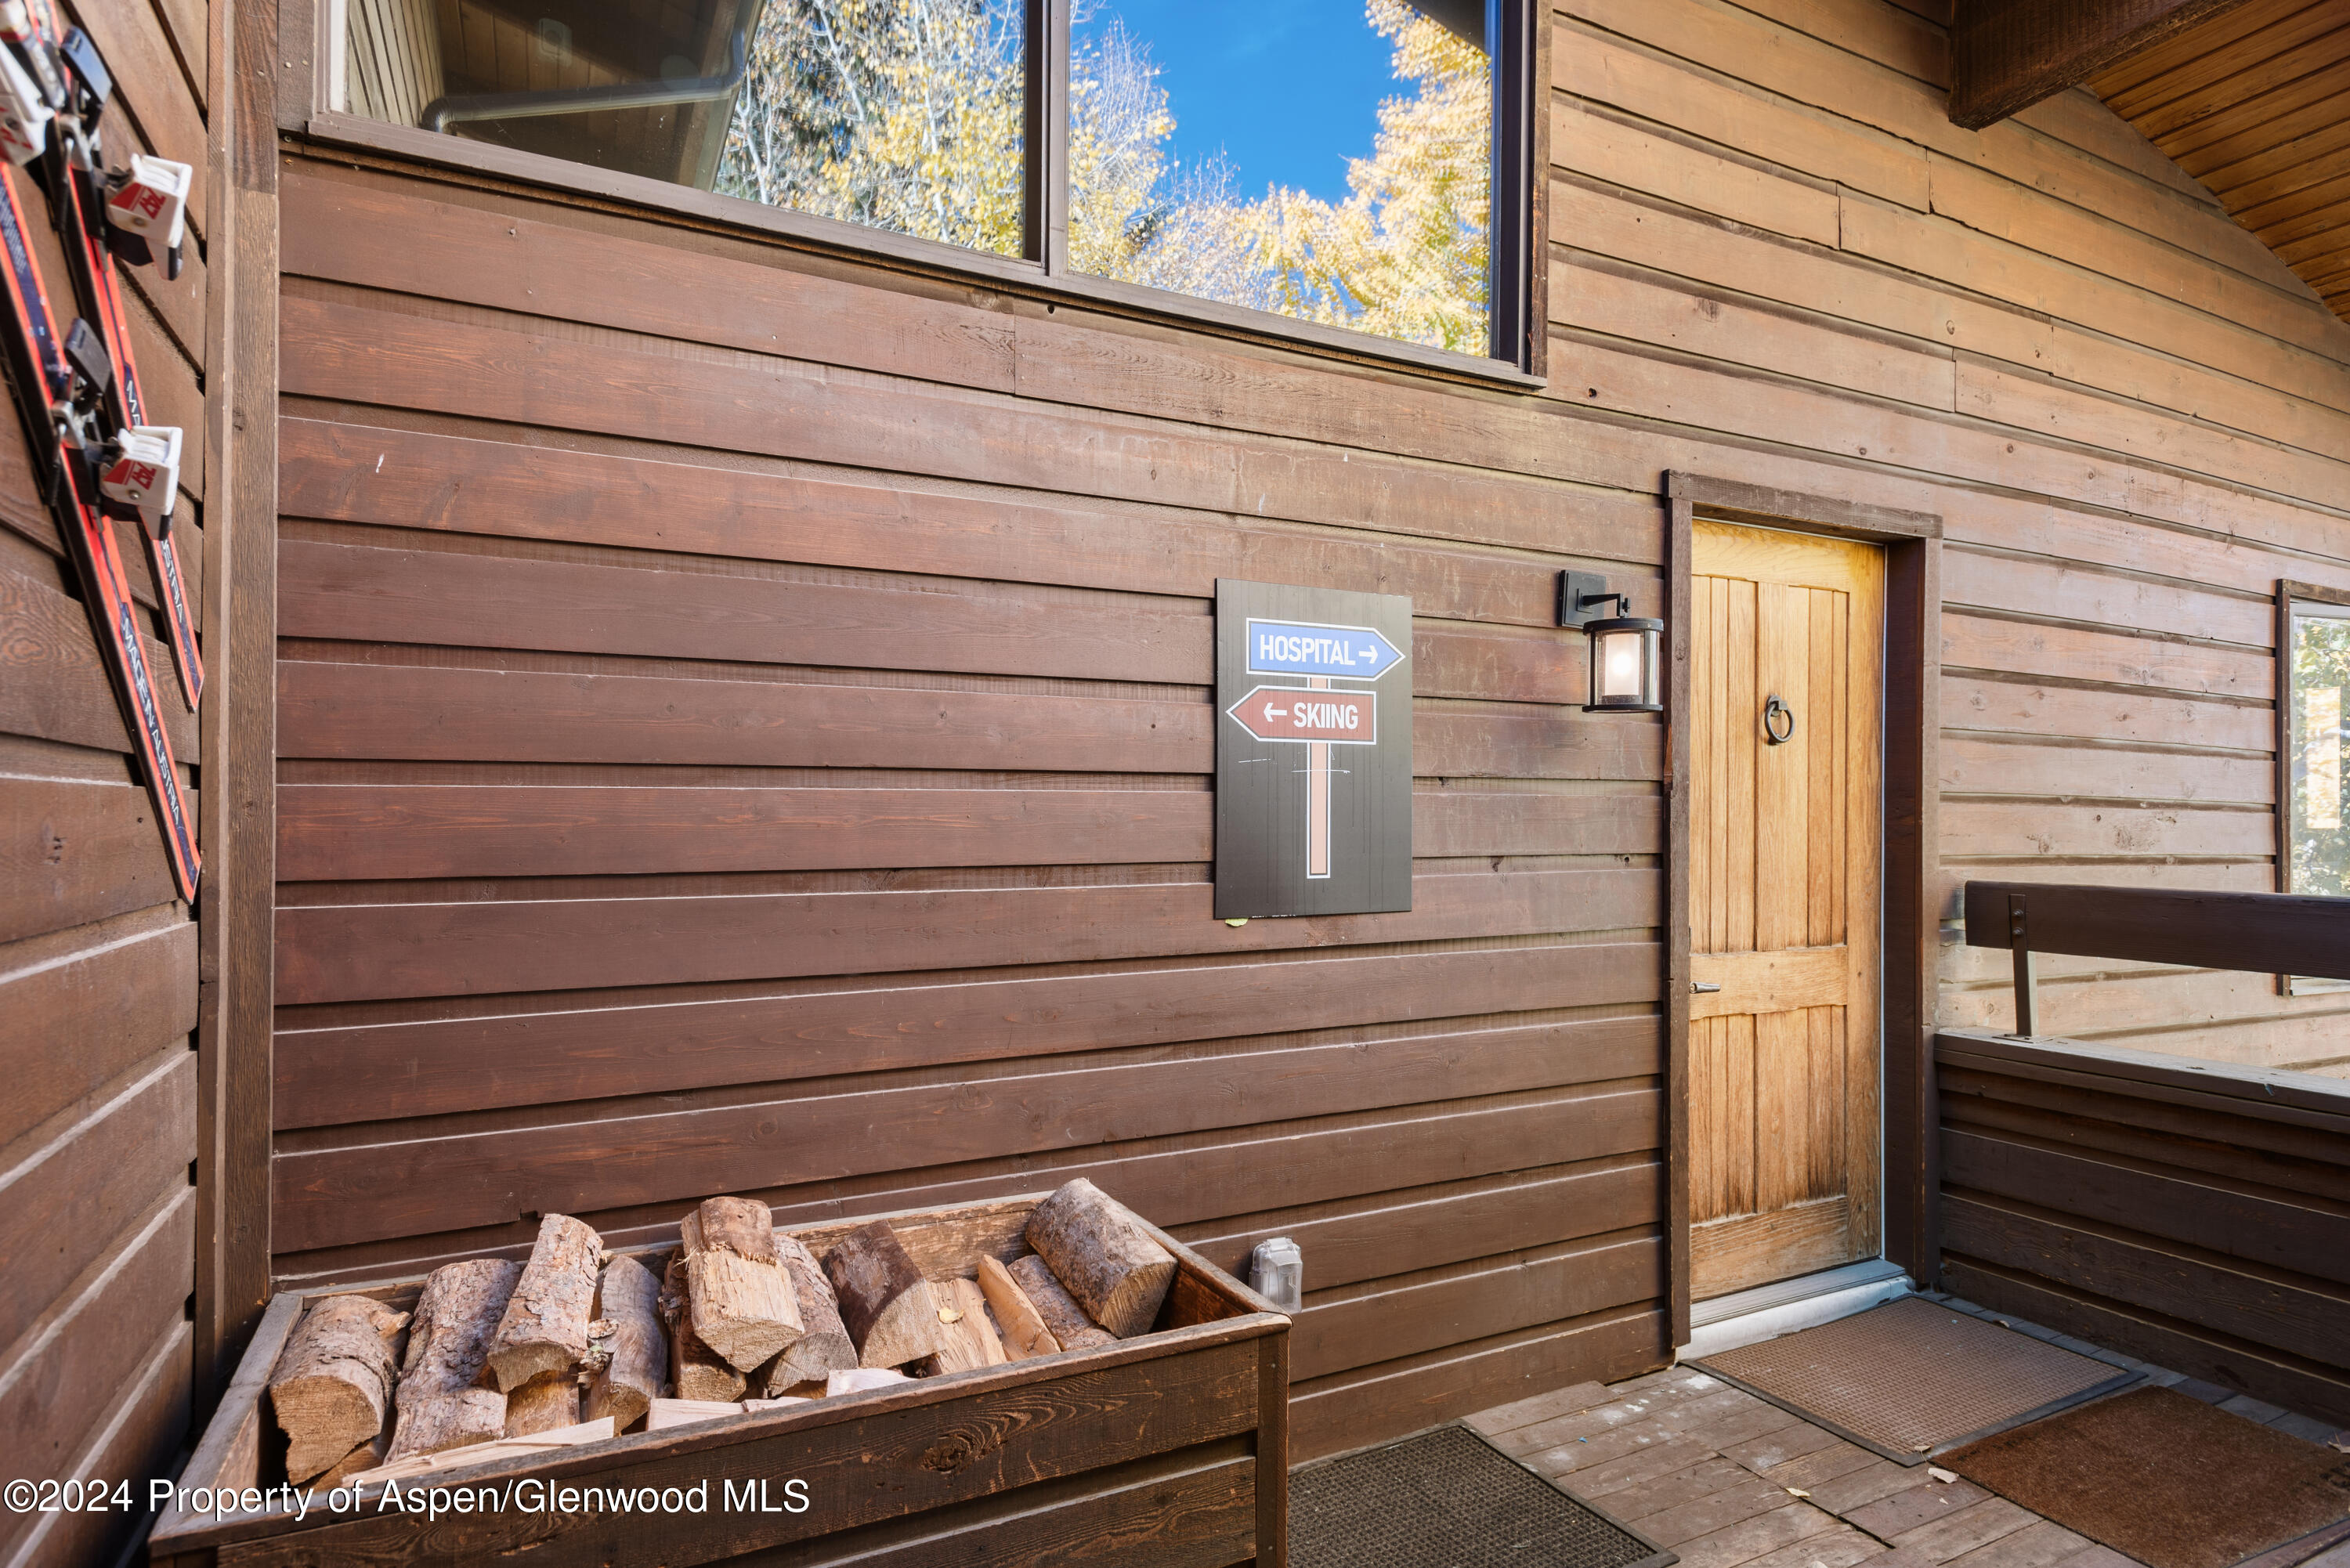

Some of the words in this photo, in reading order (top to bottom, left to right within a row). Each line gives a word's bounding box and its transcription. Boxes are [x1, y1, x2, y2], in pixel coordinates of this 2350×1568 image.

[1260, 634, 1356, 666] HOSPITAL
[123, 617, 148, 703] MADE
[145, 699, 155, 728] IN
[152, 729, 179, 825] AUSTRIA
[1293, 702, 1358, 729] SKIING
